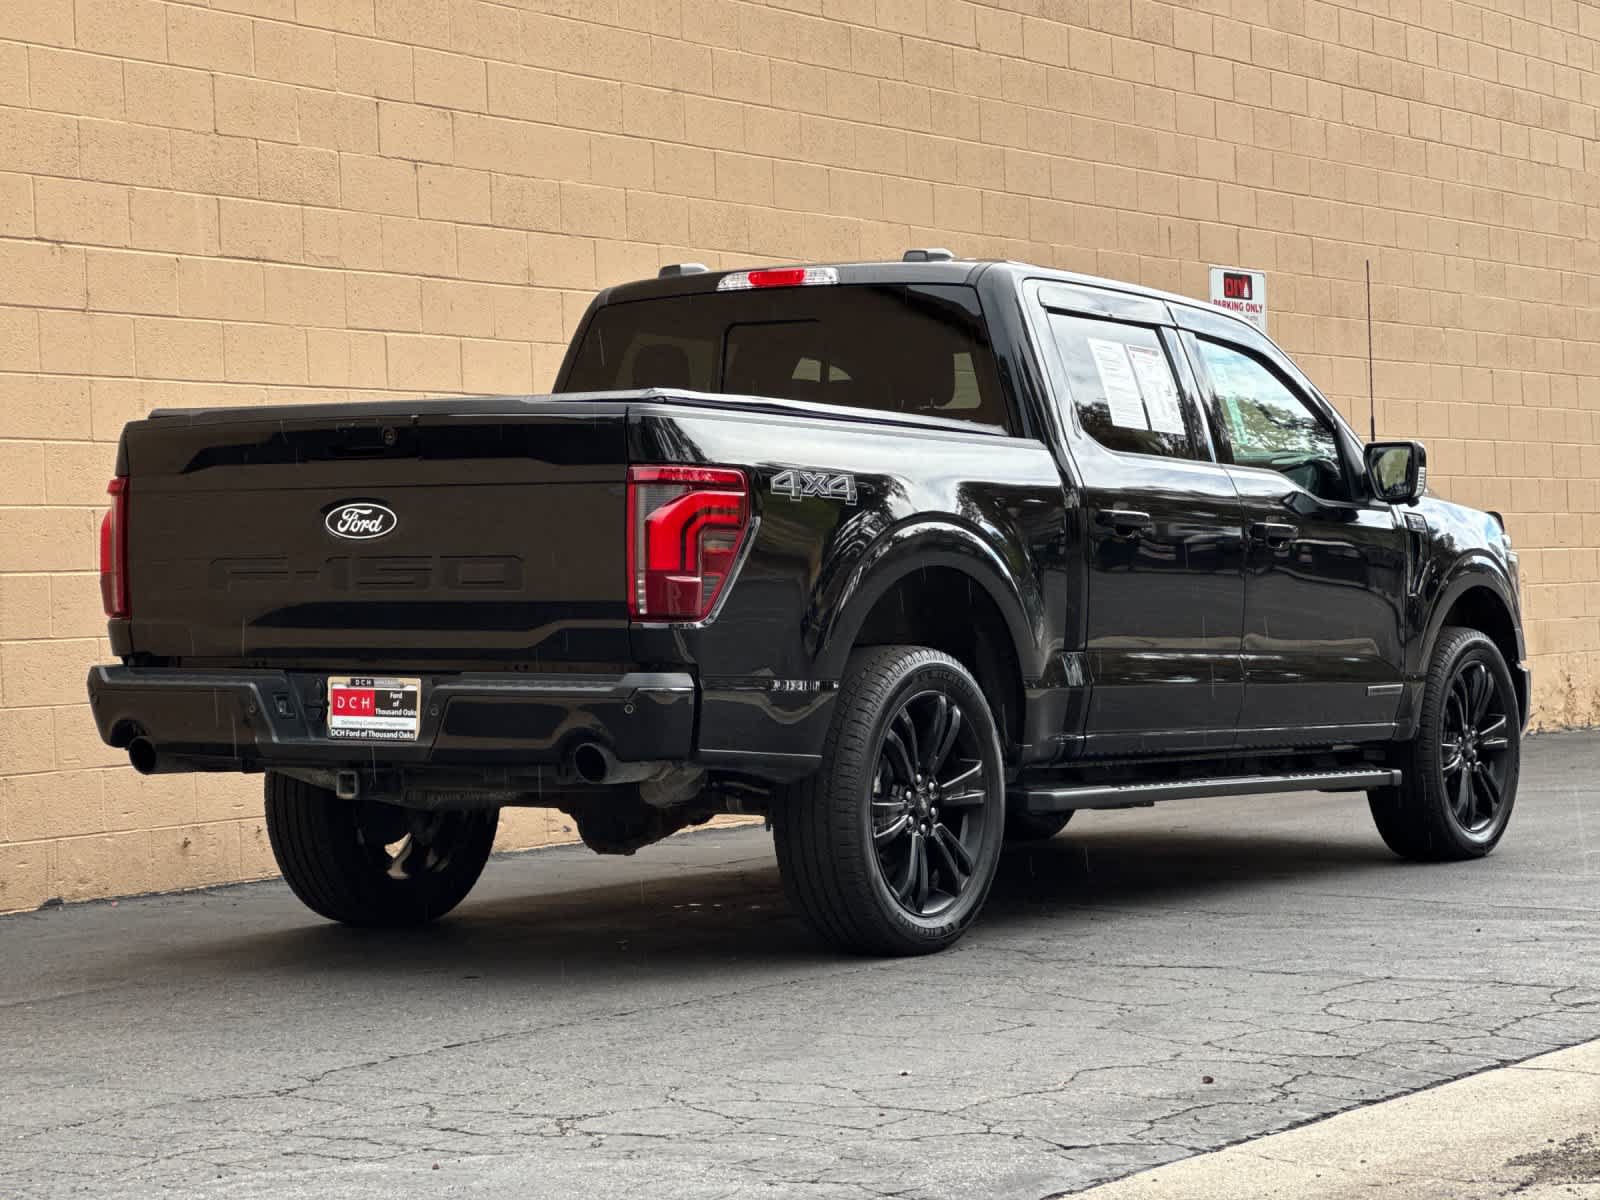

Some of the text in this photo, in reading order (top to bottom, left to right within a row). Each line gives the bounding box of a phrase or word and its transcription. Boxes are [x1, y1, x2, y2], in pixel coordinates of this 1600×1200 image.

[1246, 303, 1263, 313] ONLY
[337, 508, 384, 533] Ford
[390, 692, 402, 700] Ford
[337, 696, 370, 710] DCH
[375, 708, 416, 717] Thousand Oaks
[331, 729, 345, 737] DCH
[346, 729, 360, 737] Ford
[361, 729, 368, 737] of
[368, 730, 398, 738] Thousand
